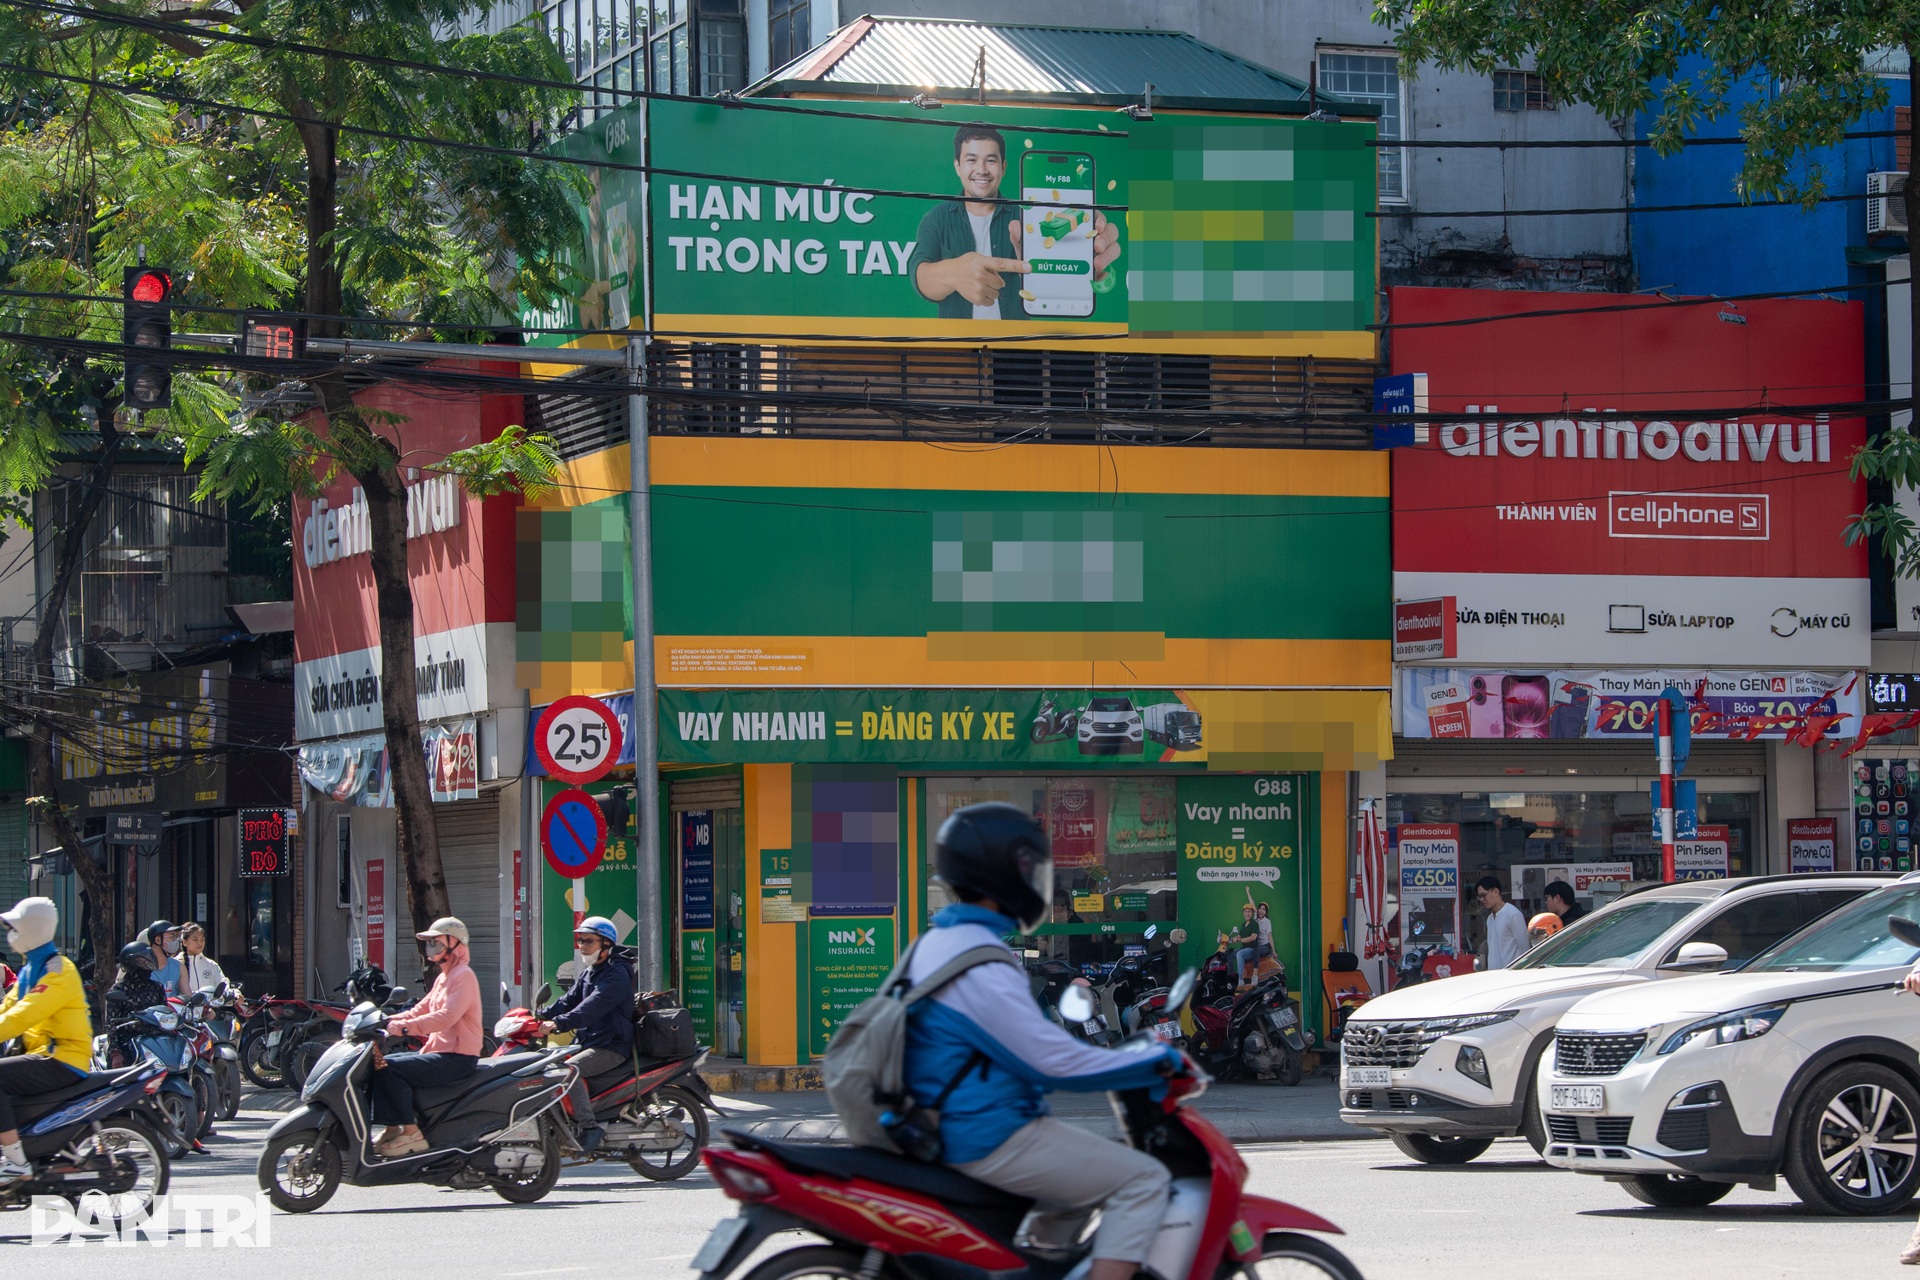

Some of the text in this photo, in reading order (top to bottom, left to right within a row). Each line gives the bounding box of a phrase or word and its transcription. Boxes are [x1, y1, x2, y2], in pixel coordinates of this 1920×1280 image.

[1057, 175, 1071, 183] F88
[669, 179, 875, 231] HẠN MỨC
[668, 237, 918, 276] TRONG TAY
[1038, 263, 1079, 272] RÚT NGAY
[1496, 502, 1597, 521] THÀNH VIÊN
[1397, 612, 1442, 631] dienthoaivui
[1484, 609, 1517, 628] ĐIỆN
[1521, 612, 1565, 628] THOẠI
[1648, 610, 1734, 629] SỬA LAPTOP
[1799, 612, 1851, 629] MÁY CŨ
[416, 651, 465, 696] MÁY TÍNH
[312, 669, 378, 714] SỬA CHỮA ĐIỆN
[1431, 687, 1458, 700] GENA
[1599, 678, 1632, 693] Thay
[1634, 678, 1661, 690] Màn
[1665, 679, 1691, 690] Hình
[1740, 677, 1786, 692] GENA
[1733, 702, 1756, 714] Bảo
[678, 711, 724, 741] VAY
[733, 711, 826, 741] NHANH
[862, 705, 933, 741] ĐĂNG
[941, 705, 974, 740] KÝ
[981, 711, 1016, 740] XE
[1438, 722, 1463, 734] SCREEN
[1253, 778, 1292, 796] F88
[117, 816, 142, 828] NGÕ 2
[1184, 803, 1223, 824] Vay
[1229, 803, 1292, 820] nhanh
[244, 812, 283, 841] PHỞ
[696, 823, 710, 846] MB
[1402, 828, 1452, 836] dienthoaivui
[603, 841, 627, 861] dễ
[1185, 841, 1292, 863] Đăng ký xe
[1403, 843, 1455, 856] Thay Màn
[1676, 844, 1722, 856] Pin Pisen
[251, 846, 278, 872] BÒ
[606, 863, 614, 872] ký
[1403, 857, 1455, 866] Laptop MacBook
[1201, 870, 1219, 878] Nhận
[828, 946, 876, 955] INSURANCE
